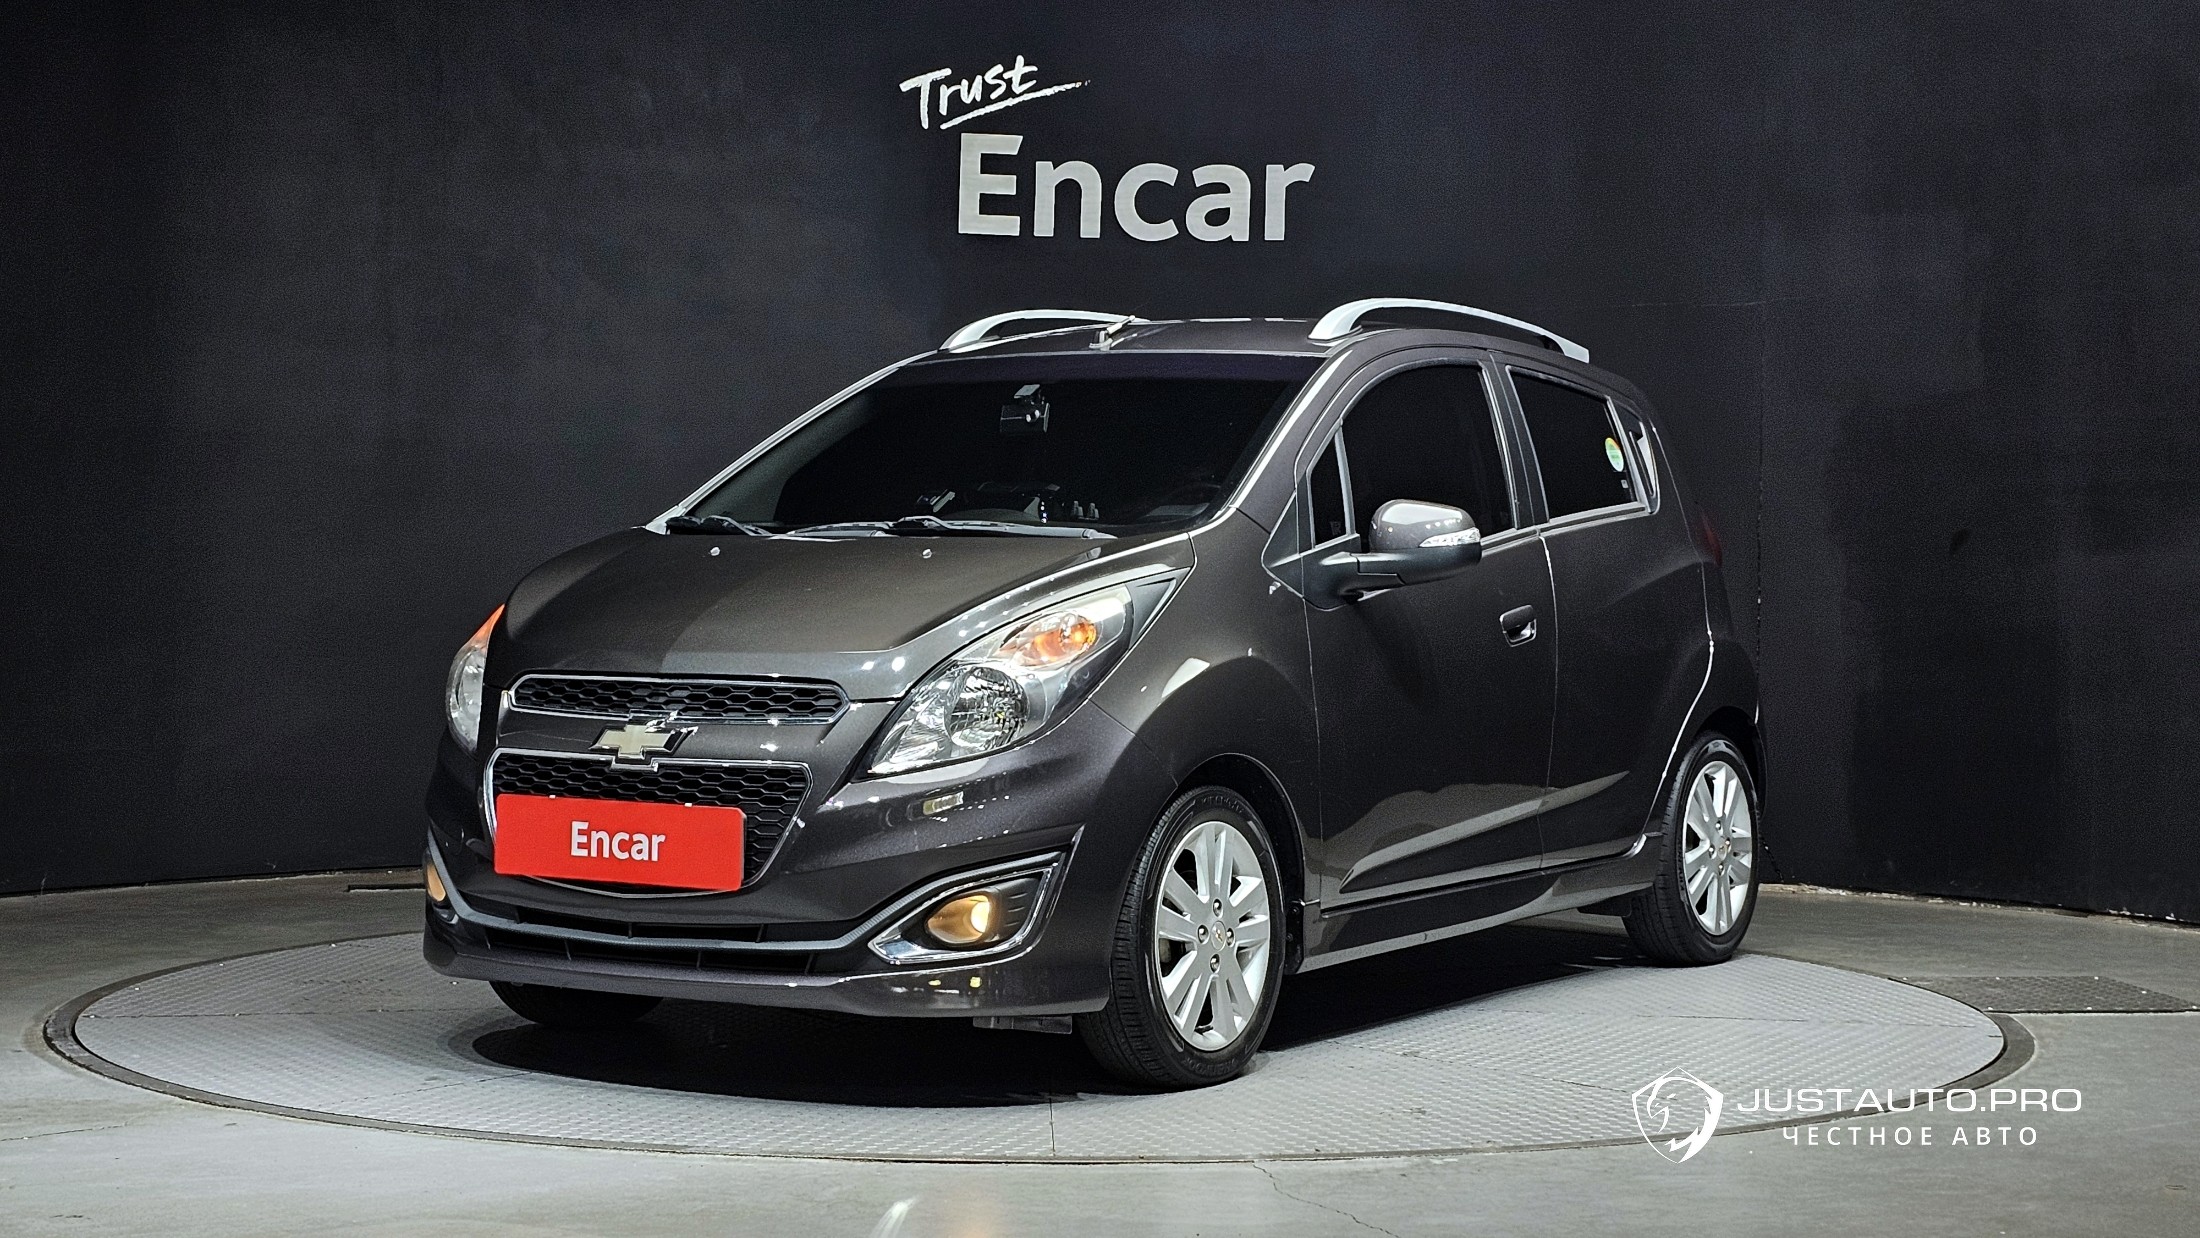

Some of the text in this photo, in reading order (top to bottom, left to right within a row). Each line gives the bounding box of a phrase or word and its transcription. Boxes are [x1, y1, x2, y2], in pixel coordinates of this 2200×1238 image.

[899, 55, 1039, 130] Trust
[957, 132, 1316, 242] Encar
[570, 821, 666, 862] Encar
